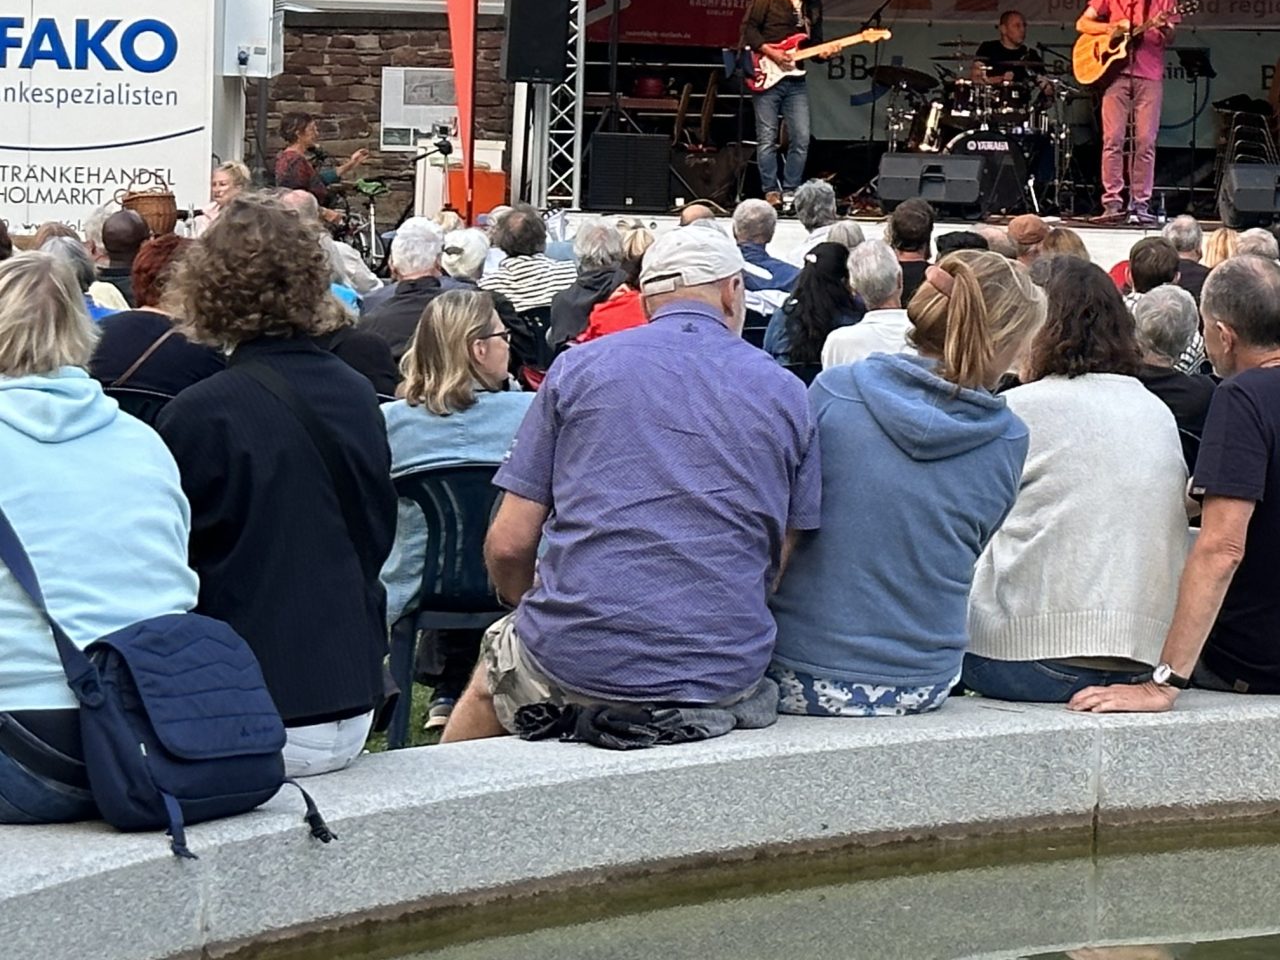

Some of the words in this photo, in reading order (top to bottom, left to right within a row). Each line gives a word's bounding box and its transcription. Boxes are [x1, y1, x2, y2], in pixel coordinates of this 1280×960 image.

[0, 16, 179, 74] FAKO
[3, 80, 178, 109] nkespezialisten
[0, 164, 176, 186] TRÄNKEHANDEL
